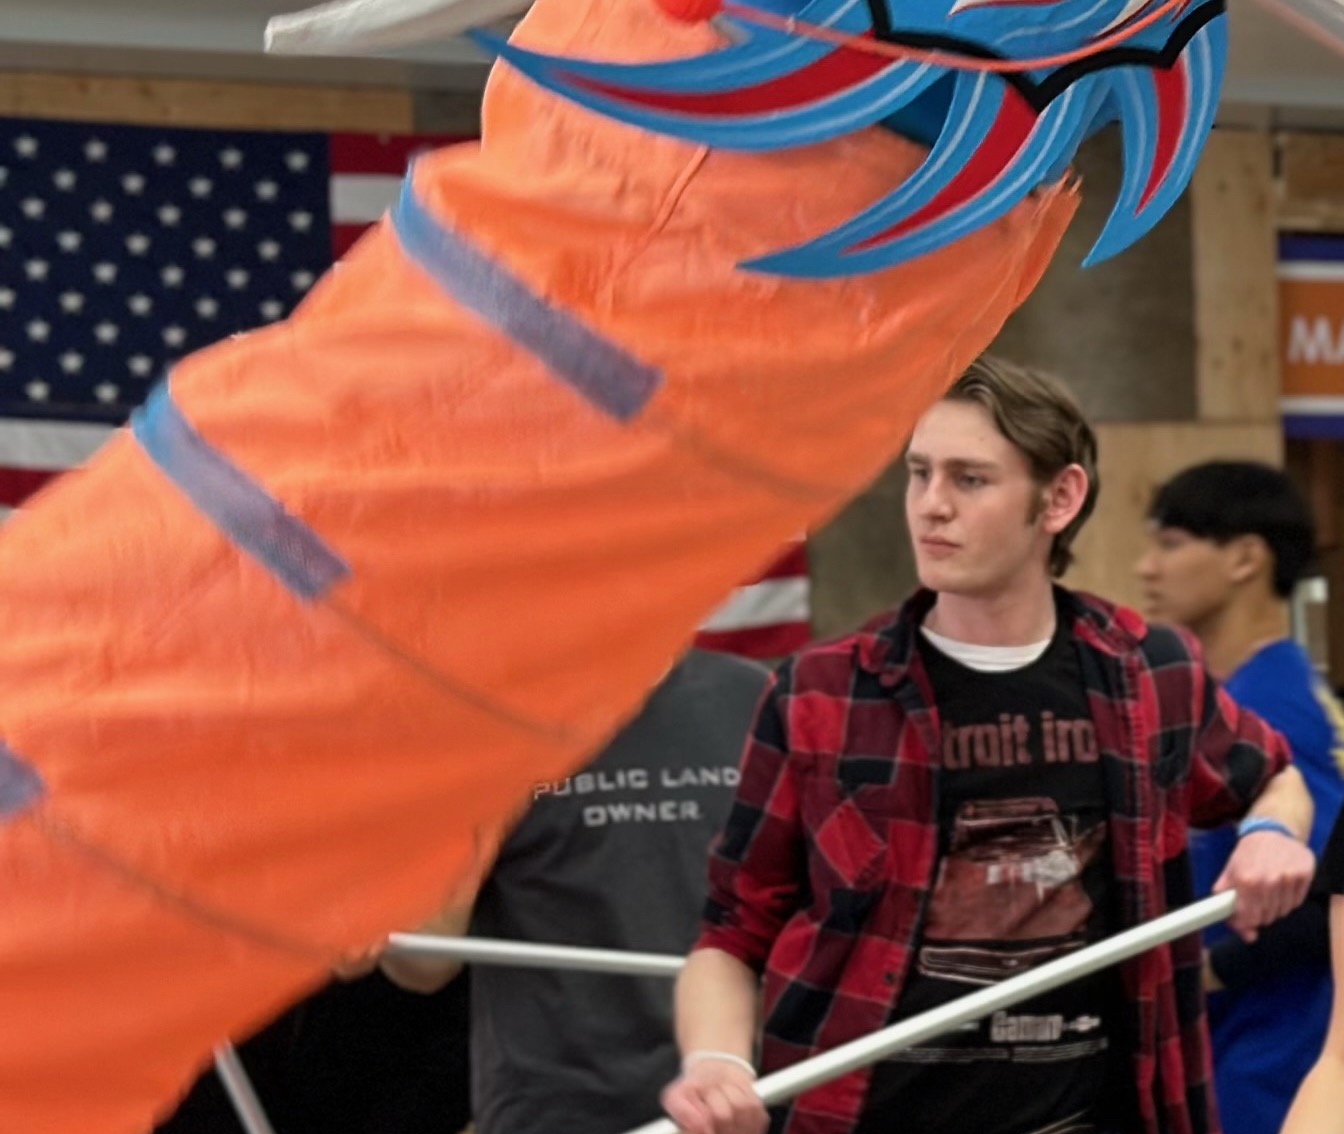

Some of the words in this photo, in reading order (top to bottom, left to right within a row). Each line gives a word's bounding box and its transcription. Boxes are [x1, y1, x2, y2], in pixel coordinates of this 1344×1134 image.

[534, 767, 649, 800] PUBLIC
[660, 765, 742, 788] LAND
[583, 800, 702, 827] OWNER
